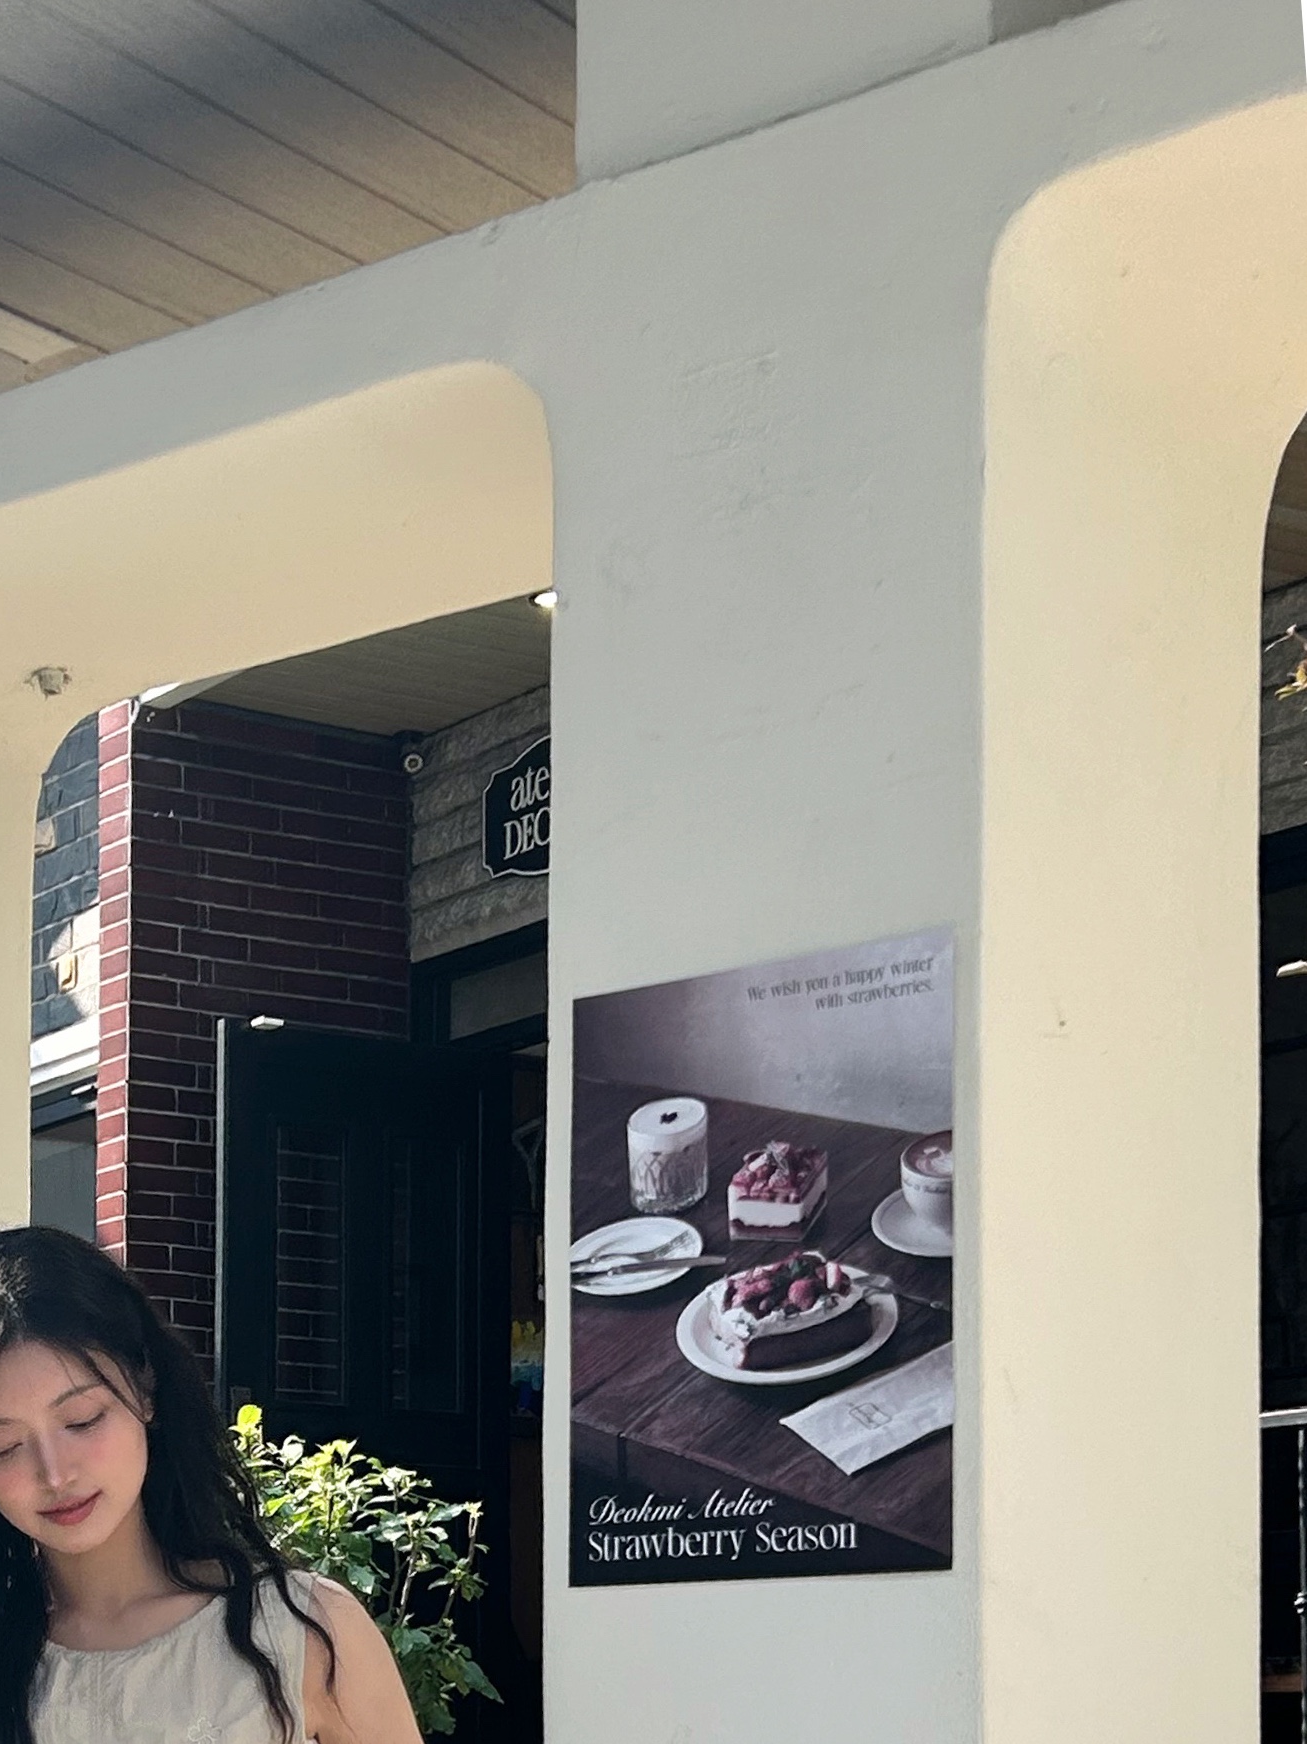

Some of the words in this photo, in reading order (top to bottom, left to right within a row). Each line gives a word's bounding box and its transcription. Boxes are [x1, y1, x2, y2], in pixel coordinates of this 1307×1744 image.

[510, 766, 549, 812] ate
[503, 806, 550, 860] DEO
[747, 985, 767, 1001] We
[770, 979, 802, 998] wish
[804, 975, 829, 996] you
[832, 974, 842, 988] a
[844, 966, 886, 987] happy
[890, 956, 935, 977] winter
[815, 992, 844, 1011] with
[588, 1493, 688, 1526] Deokmi
[688, 1486, 779, 1521] Atelier
[588, 1526, 747, 1562] Strawberry
[755, 1521, 858, 1553] Season
